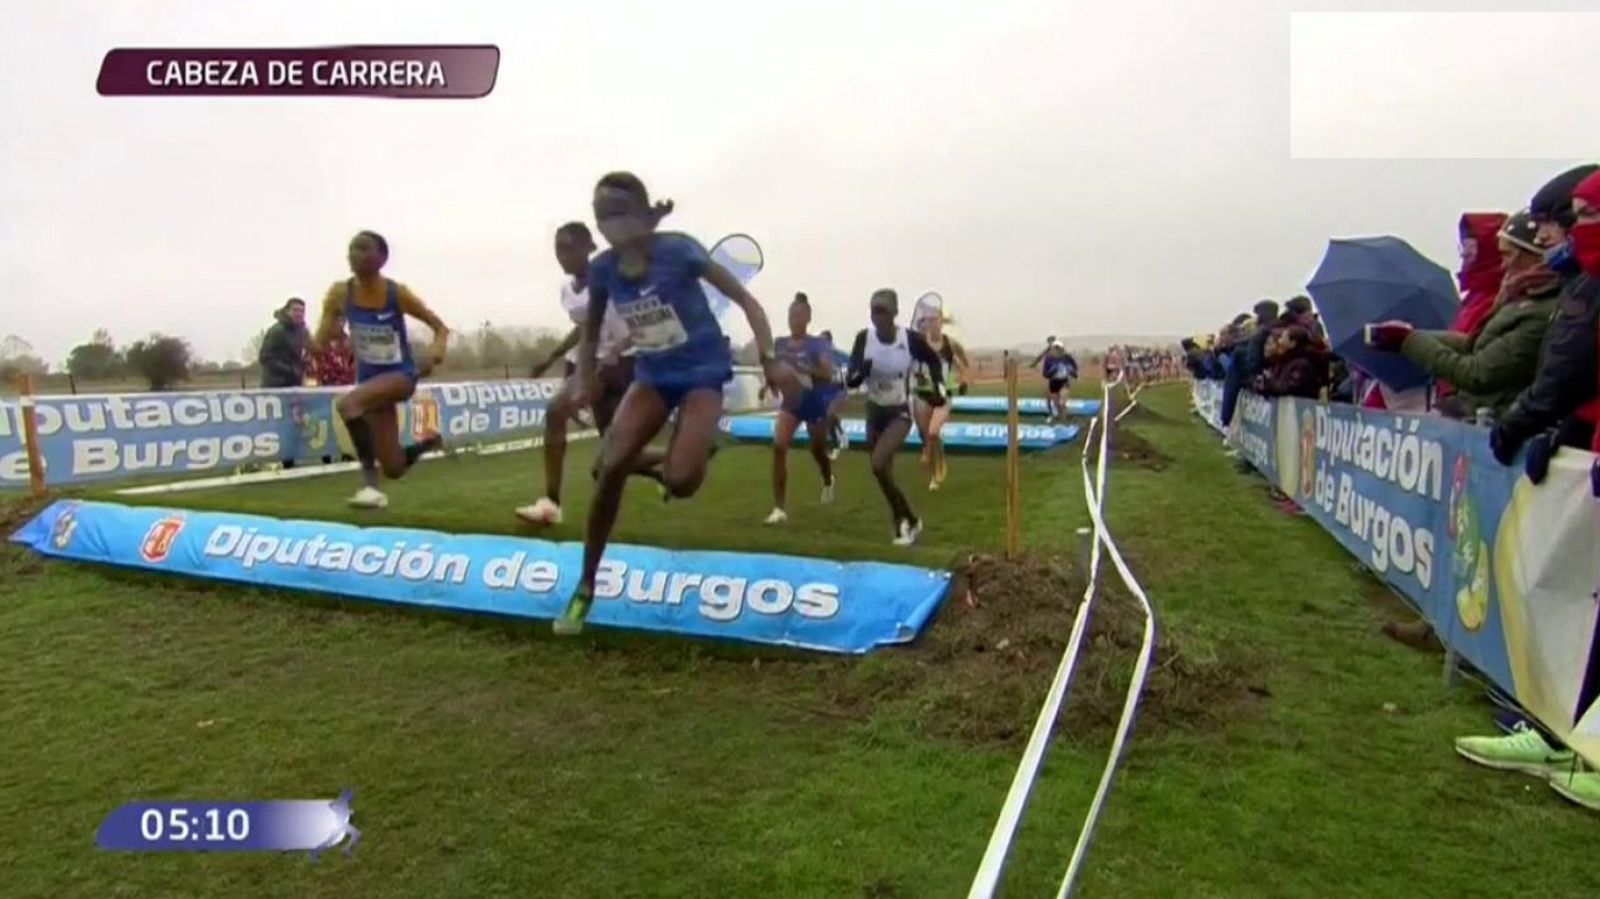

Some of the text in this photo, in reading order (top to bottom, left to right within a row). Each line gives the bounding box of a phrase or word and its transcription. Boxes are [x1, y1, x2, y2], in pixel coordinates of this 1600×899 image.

[0, 393, 283, 445] iputación
[0, 431, 280, 479] e Burgos
[449, 405, 547, 435] de Bur
[1314, 405, 1444, 500] Diputación
[1314, 460, 1335, 513] de
[1335, 473, 1435, 590] Burgos
[204, 523, 841, 622] Diputación de Burgos
